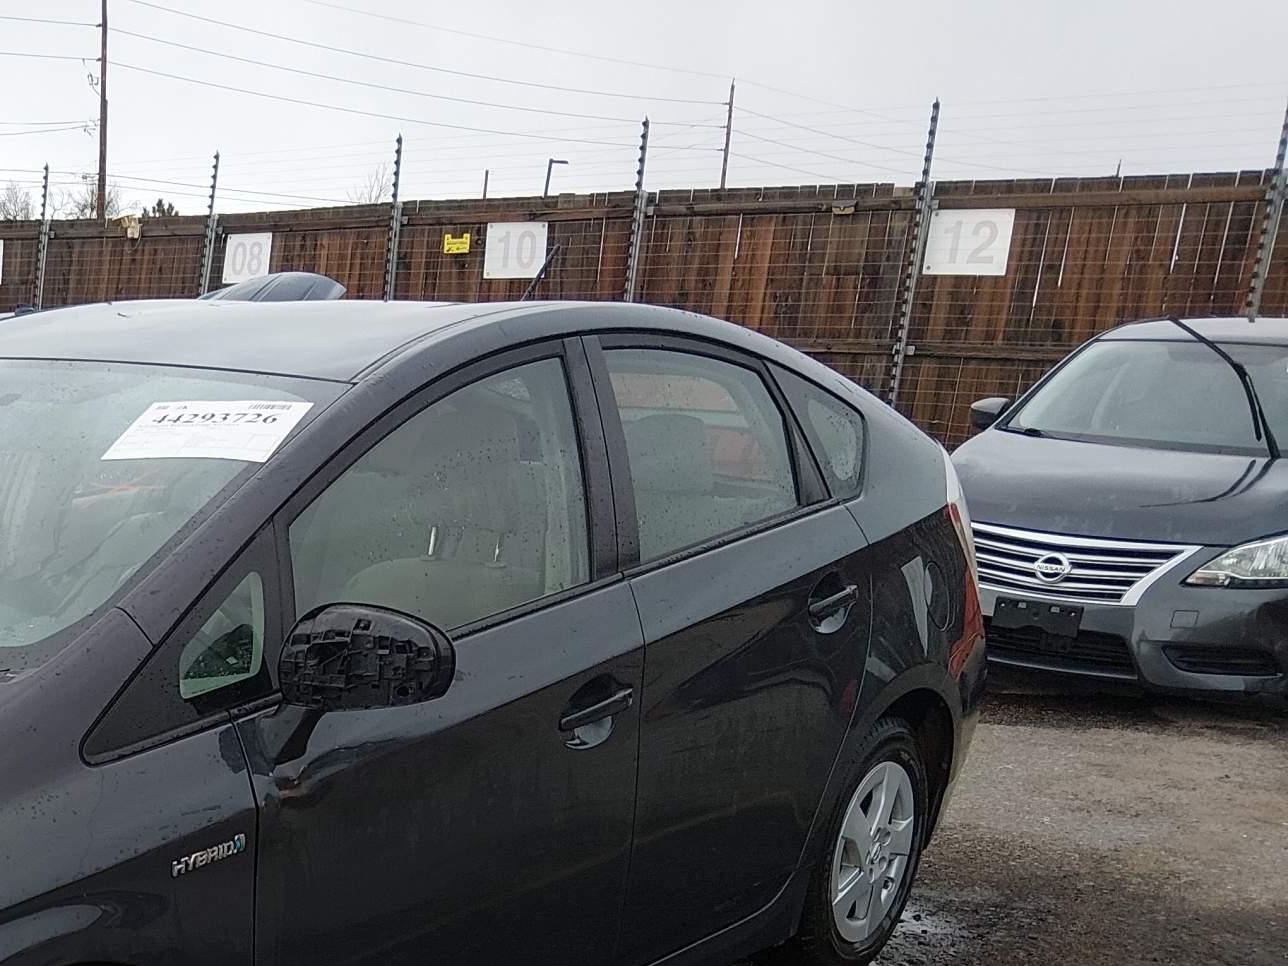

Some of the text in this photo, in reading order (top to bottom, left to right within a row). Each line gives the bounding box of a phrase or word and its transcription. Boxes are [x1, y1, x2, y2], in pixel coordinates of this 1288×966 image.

[232, 241, 263, 276] 08
[497, 230, 537, 270] 10
[943, 220, 999, 264] 12
[152, 412, 279, 424] 44293726
[1036, 564, 1066, 573] NISSAN
[172, 840, 235, 877] HYBRID
